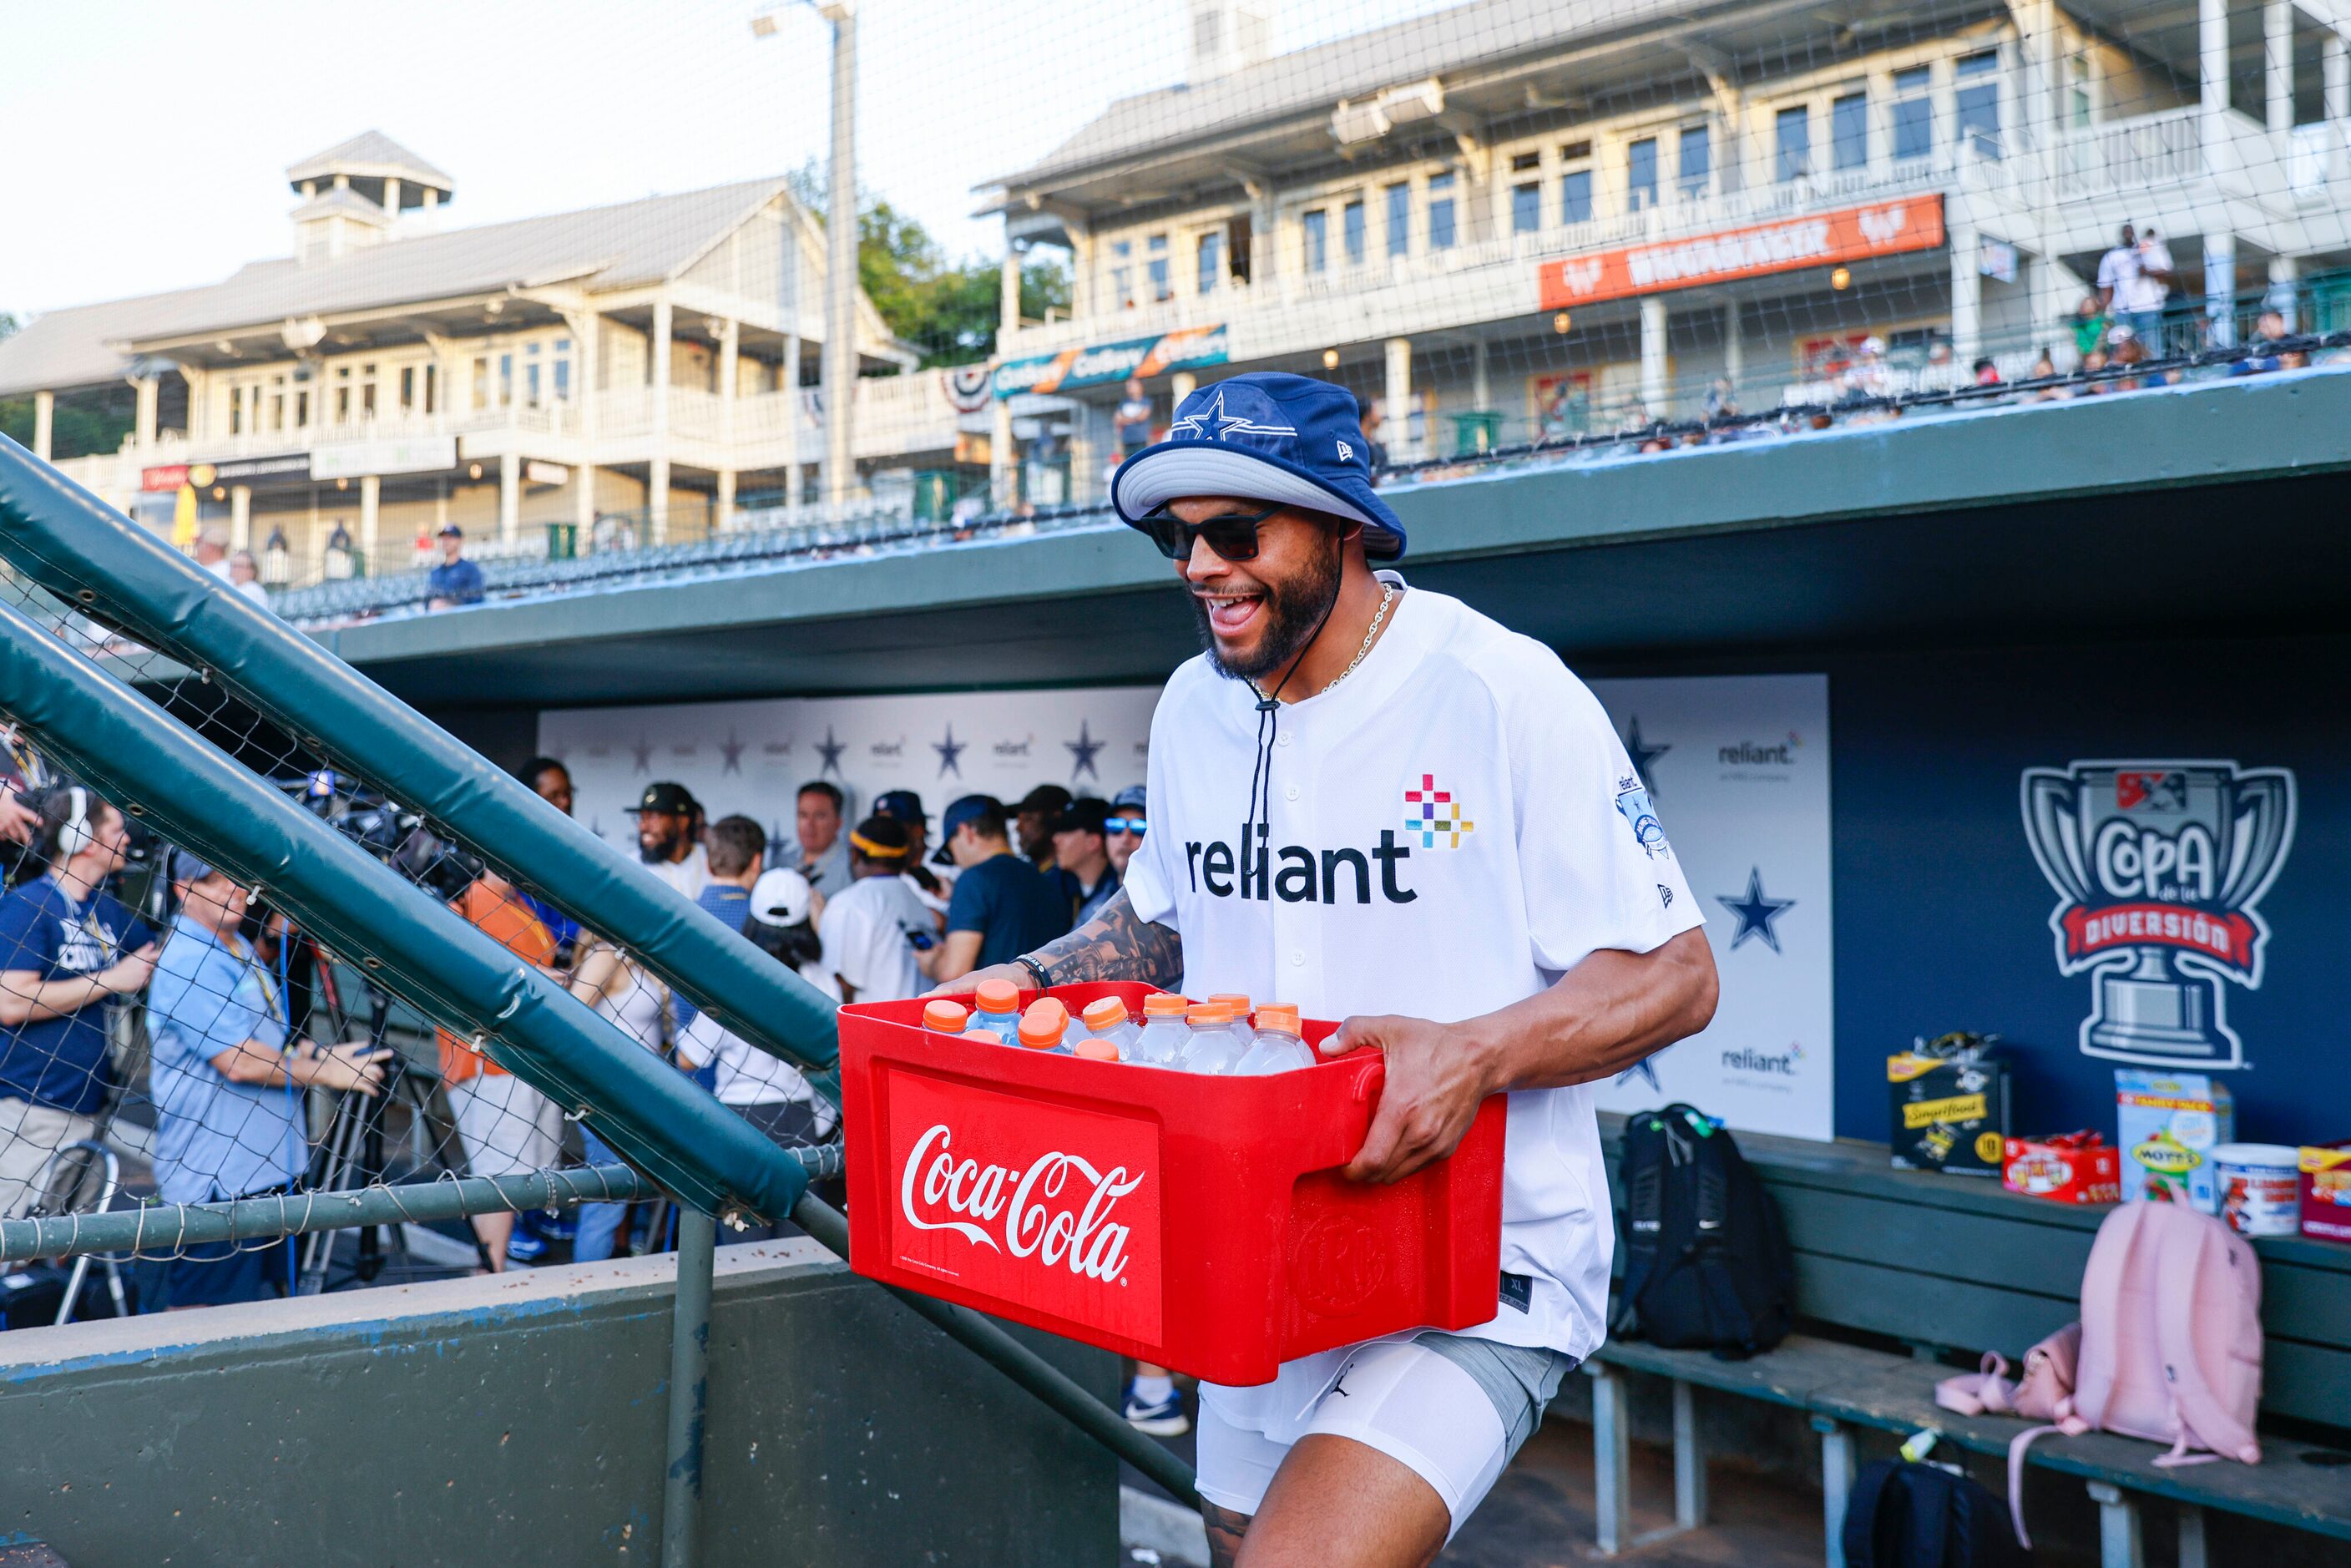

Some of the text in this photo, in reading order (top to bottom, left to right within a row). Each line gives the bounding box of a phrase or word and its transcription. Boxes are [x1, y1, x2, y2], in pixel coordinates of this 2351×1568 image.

[1186, 823, 1418, 904] reliant
[902, 1125, 1145, 1282] Coca-Cola
[1511, 1278, 1523, 1292] XL
